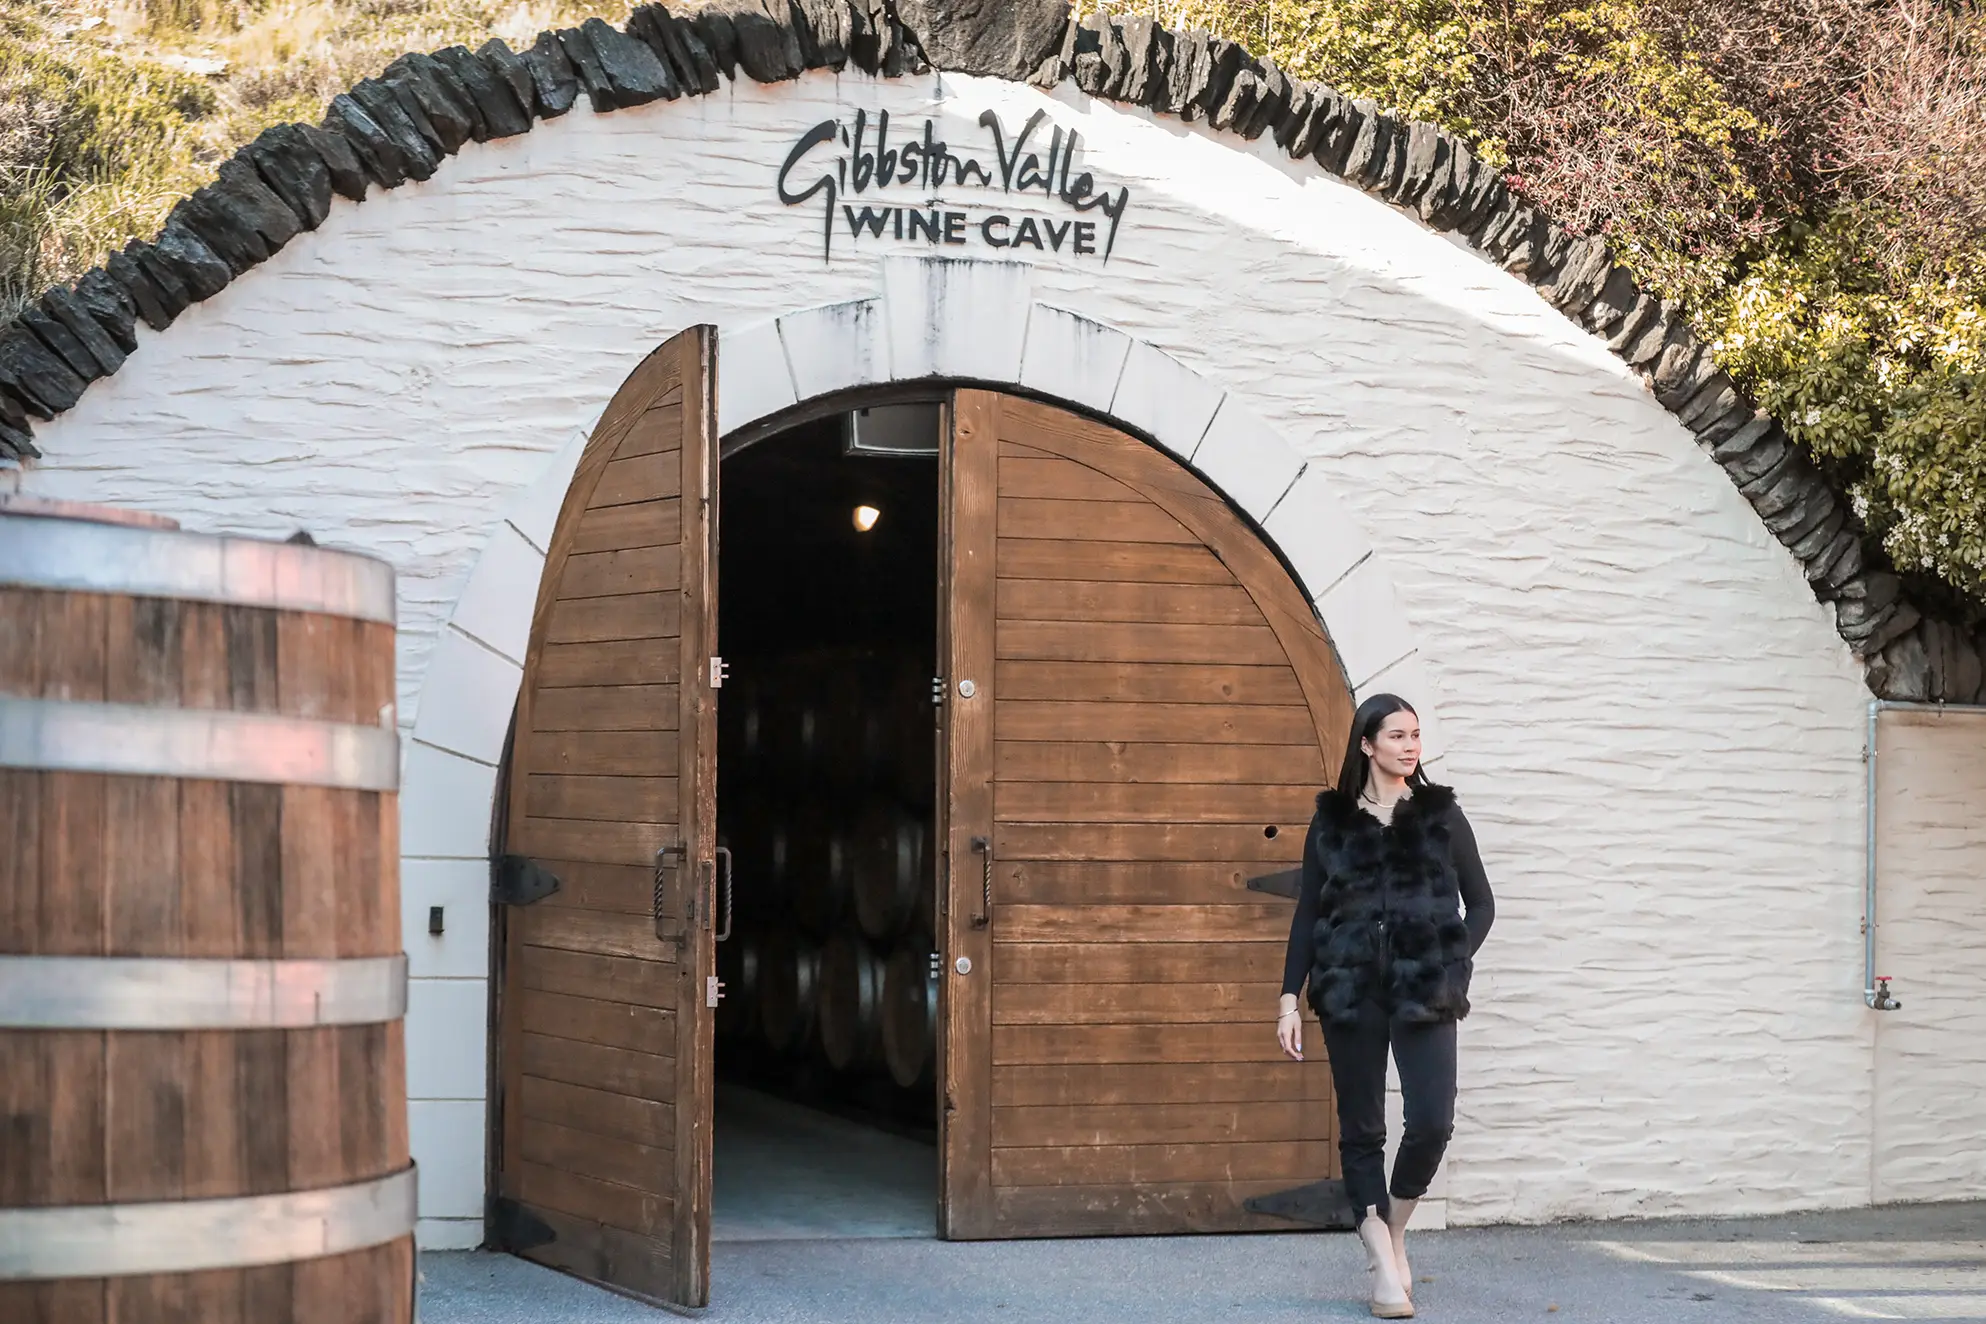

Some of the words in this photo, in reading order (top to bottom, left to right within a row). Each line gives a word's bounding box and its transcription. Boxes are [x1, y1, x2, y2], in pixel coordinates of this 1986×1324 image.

[778, 108, 992, 263] Gibbston
[979, 108, 1129, 267] Valley
[842, 204, 967, 245] WINE
[981, 215, 1096, 254] CAVE
